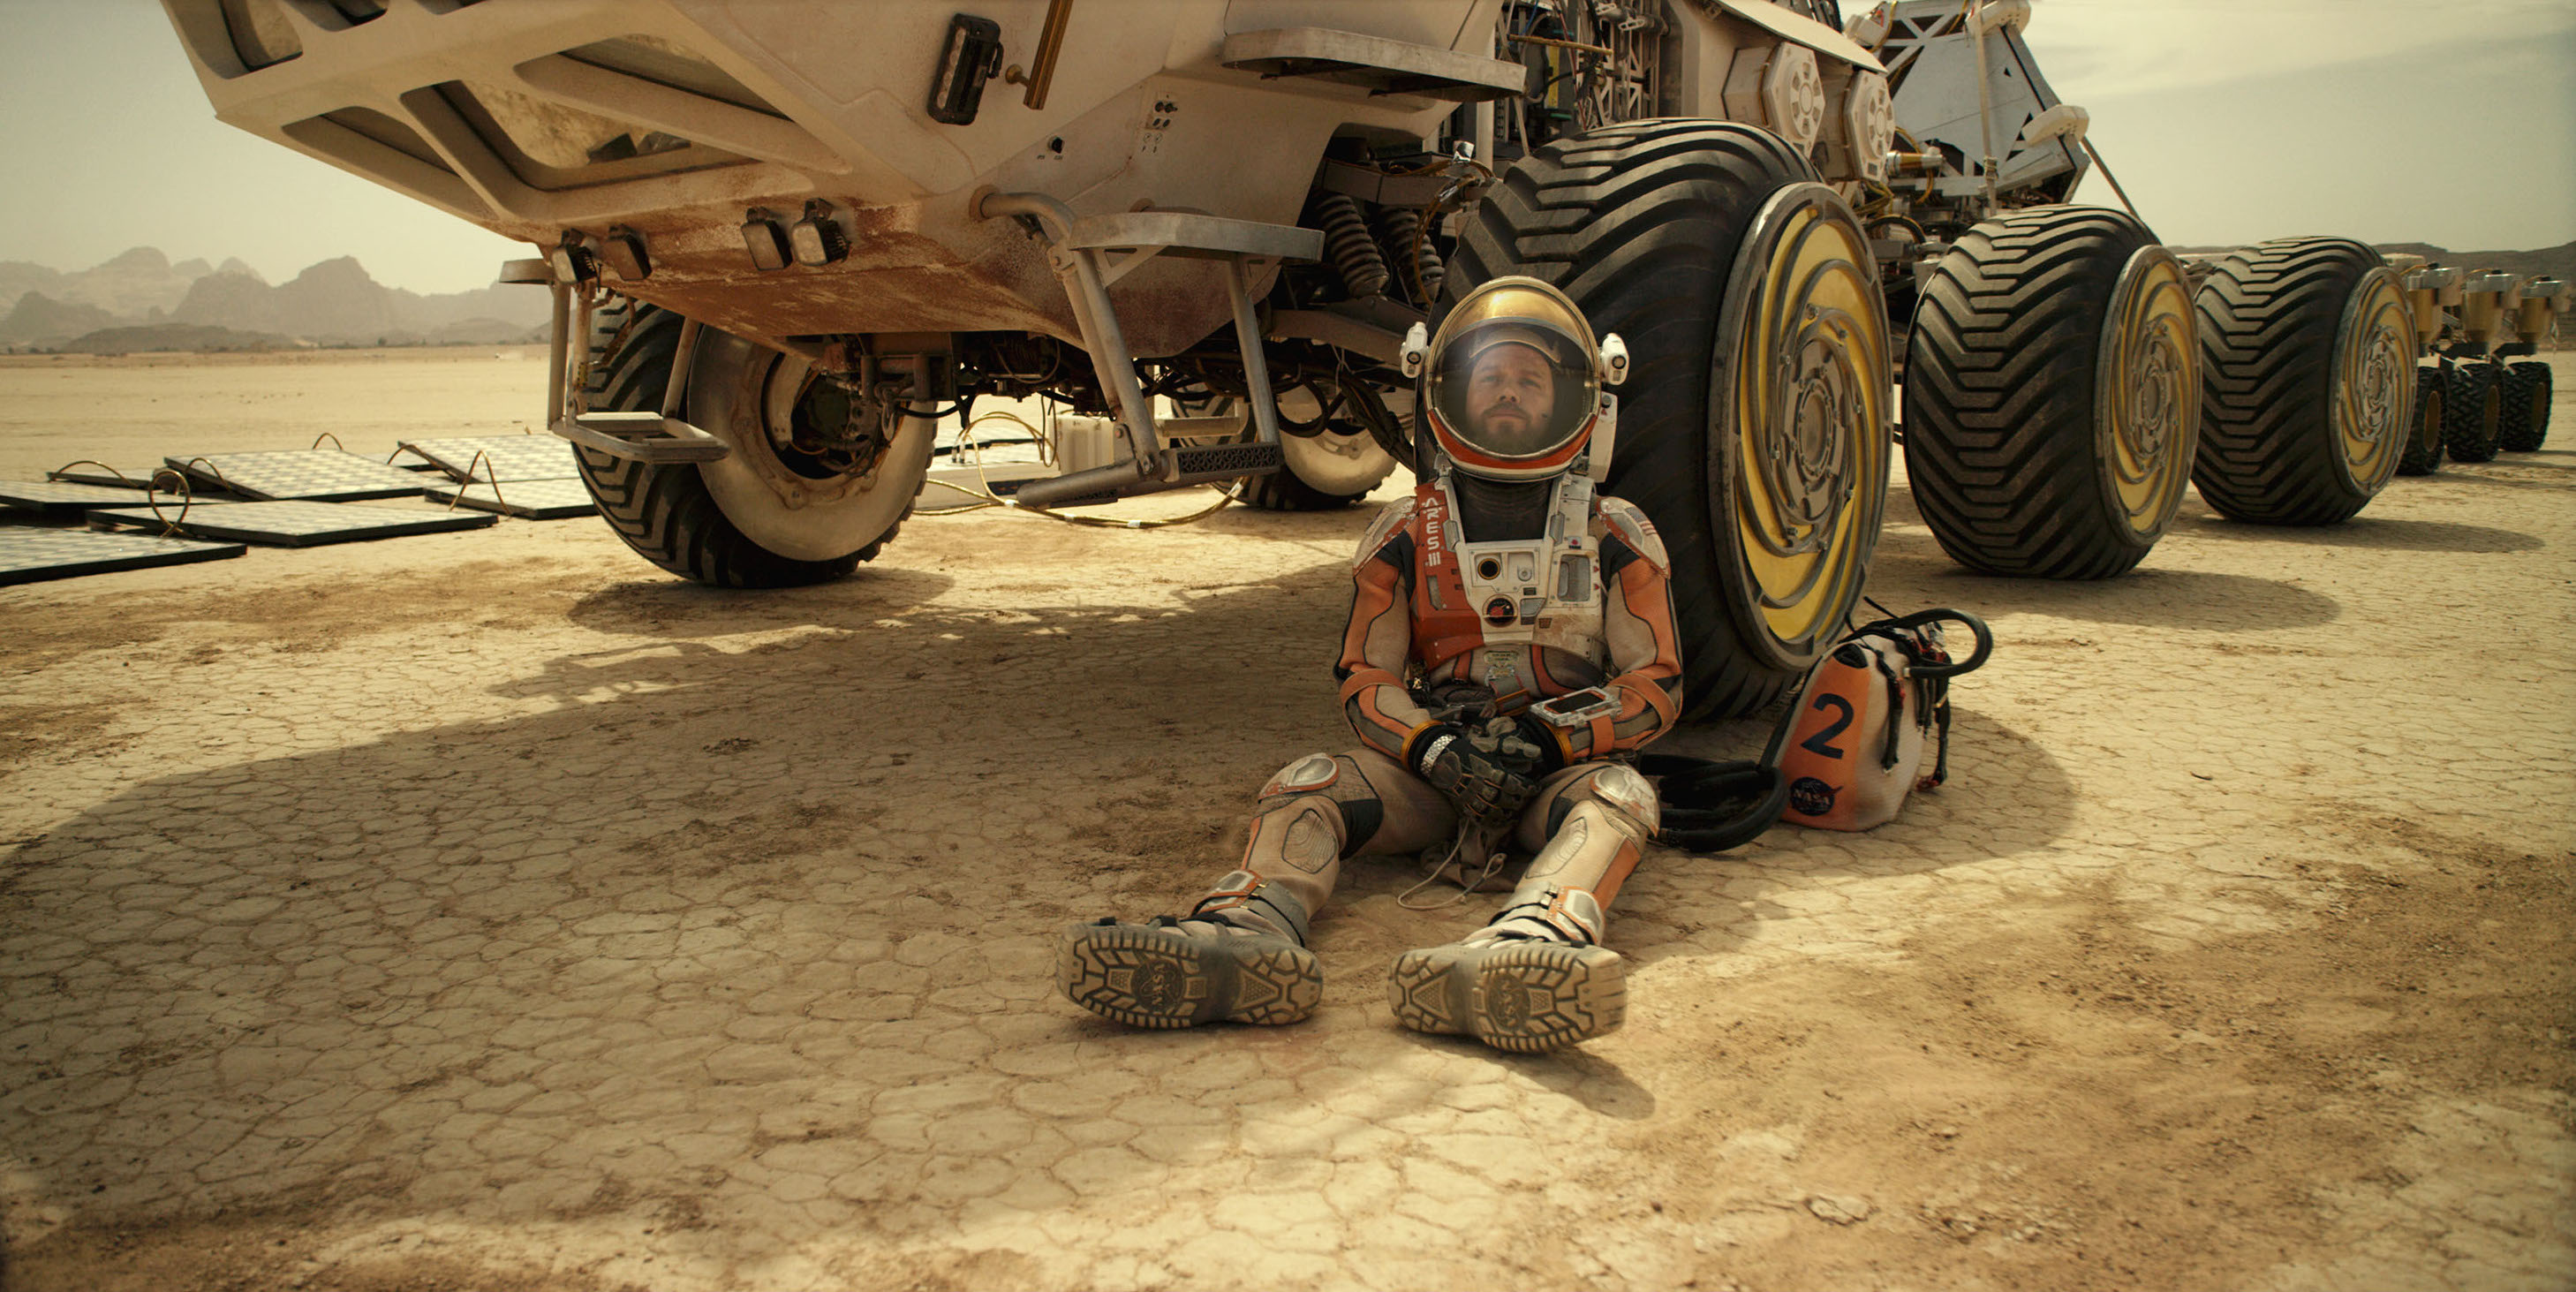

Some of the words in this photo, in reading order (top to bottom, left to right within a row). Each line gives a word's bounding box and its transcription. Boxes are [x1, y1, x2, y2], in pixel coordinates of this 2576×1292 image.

[1424, 497, 1440, 550] ARES
[1800, 693, 1855, 759] 2
[1794, 788, 1831, 805] NASA
